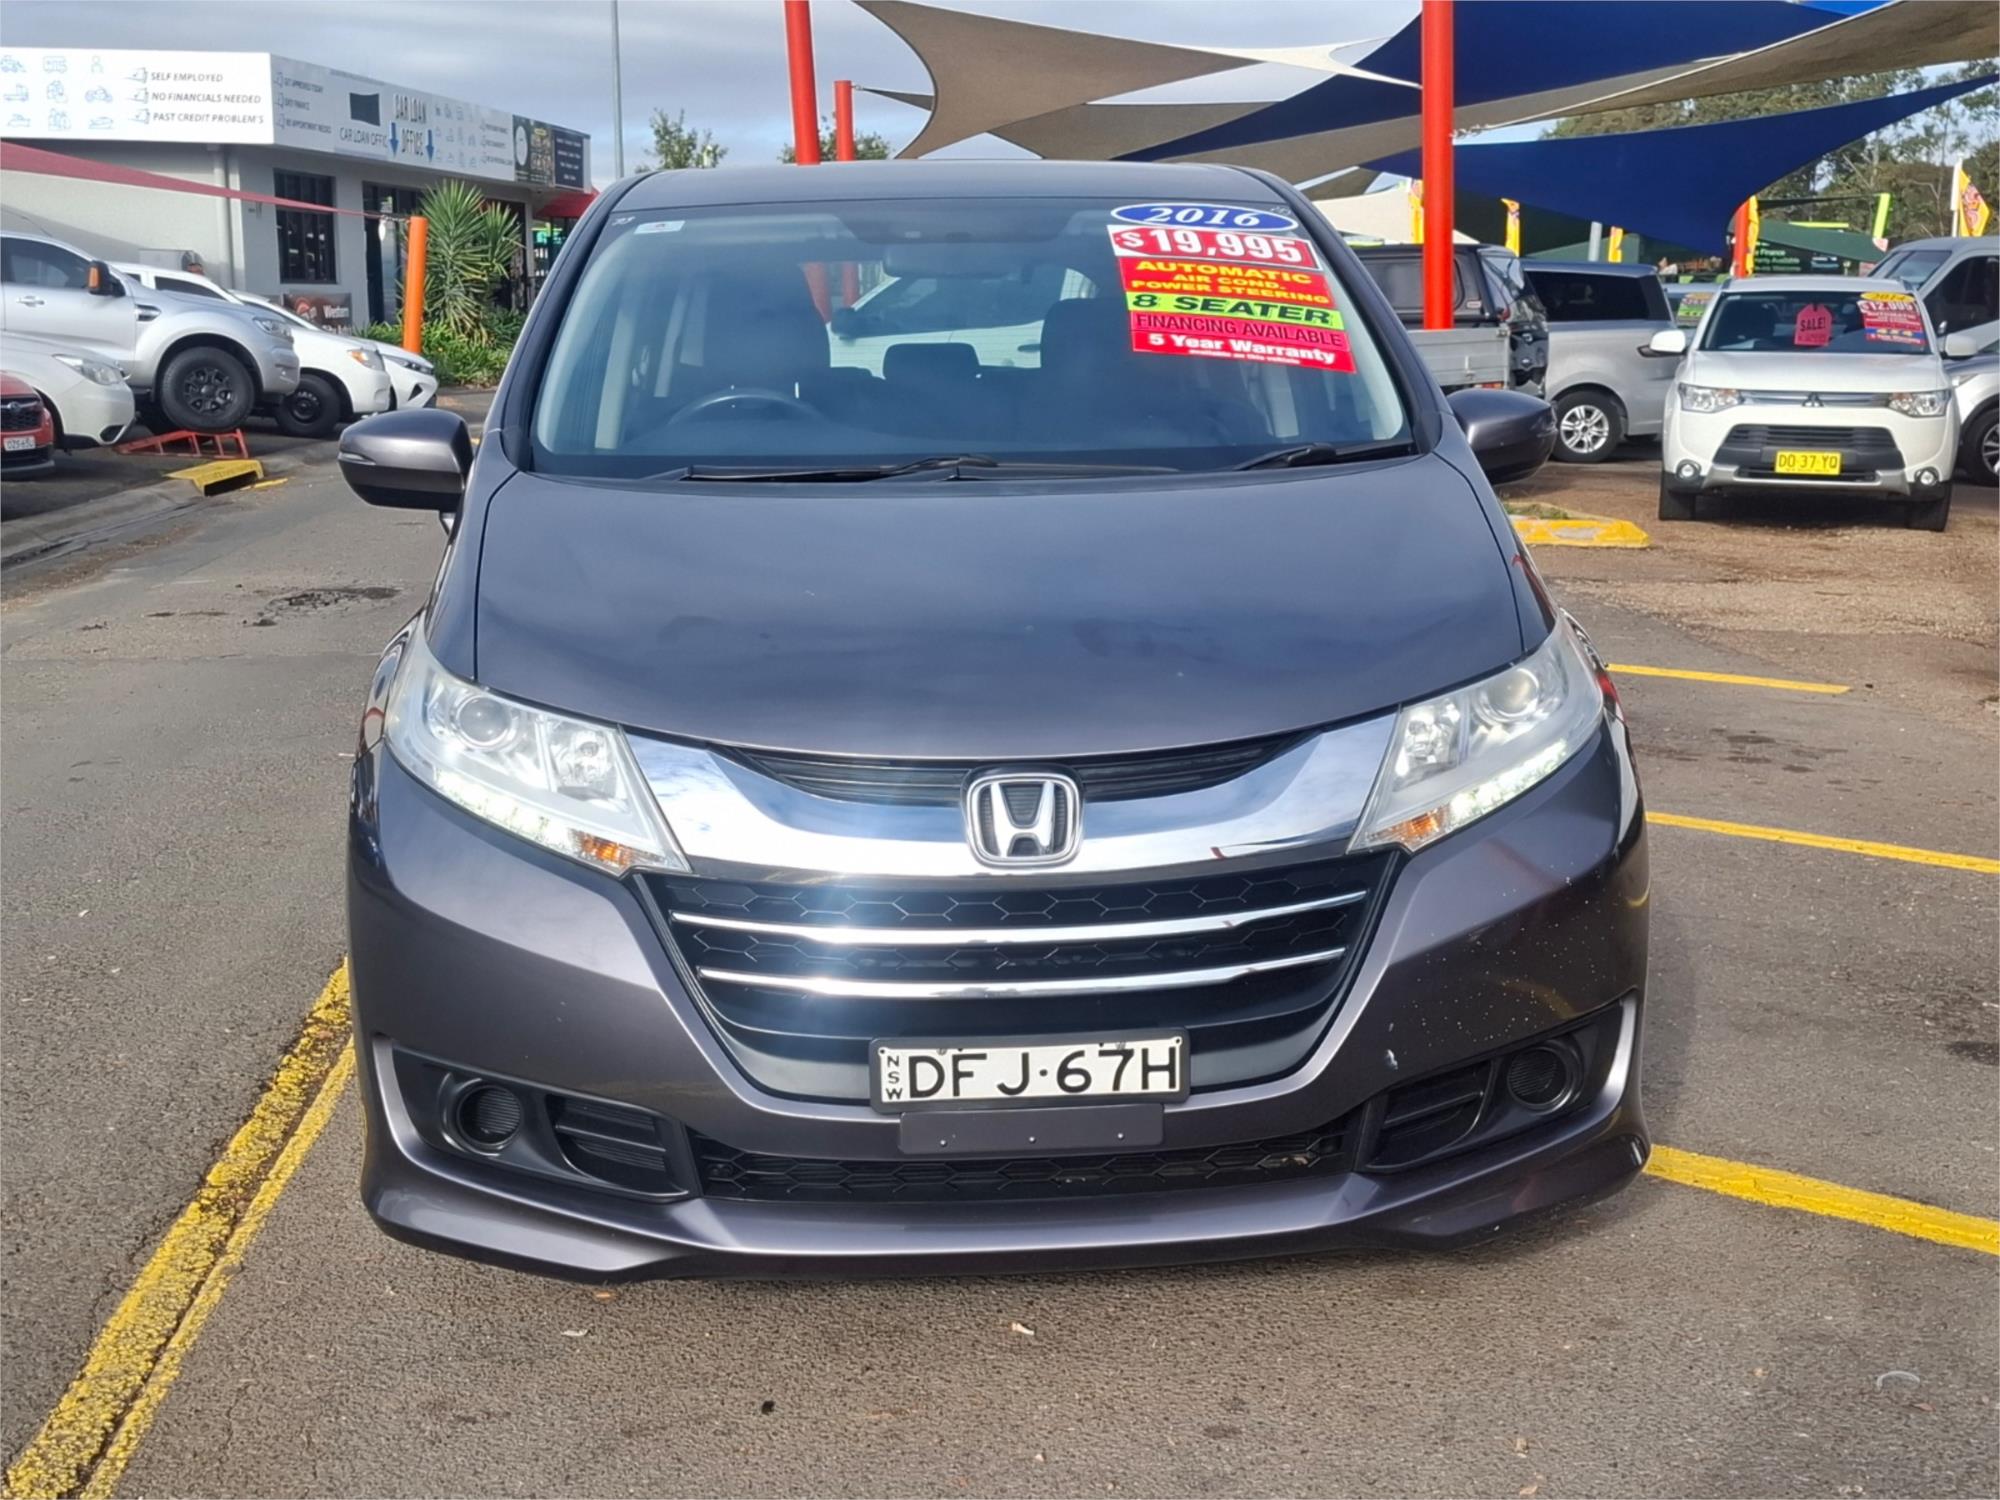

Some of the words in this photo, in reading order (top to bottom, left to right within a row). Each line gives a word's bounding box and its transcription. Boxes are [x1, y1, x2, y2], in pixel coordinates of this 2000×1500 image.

[151, 72, 171, 81] SELF
[173, 73, 223, 82] EMPLOYED
[152, 92, 166, 101] NO
[168, 93, 222, 102] FINANCIALS
[224, 94, 261, 104] NEEDED
[394, 93, 408, 120] CAR
[410, 98, 427, 124] LOAN
[153, 112, 175, 121] PAST
[177, 113, 210, 122] CREDIT
[212, 114, 264, 124] PROBLEM'S
[354, 129, 370, 144] LOAN
[1144, 207, 1260, 228] 2016
[1121, 229, 1303, 263] $19,995
[1136, 261, 1312, 284] AUTOMATIC
[1173, 274, 1211, 284] AIR
[1218, 276, 1286, 289] COND.
[1132, 280, 1211, 292] POWER
[1217, 285, 1329, 304] STEERING
[1132, 294, 1158, 308] 8
[1174, 295, 1330, 324] SEATER
[1137, 314, 1236, 334] FINANCING
[1242, 323, 1342, 347] AVAILABLE
[1800, 316, 1826, 332] SALE!
[1150, 333, 1165, 345] 5
[1169, 335, 1223, 350] Year
[1229, 339, 1335, 364] Warranty
